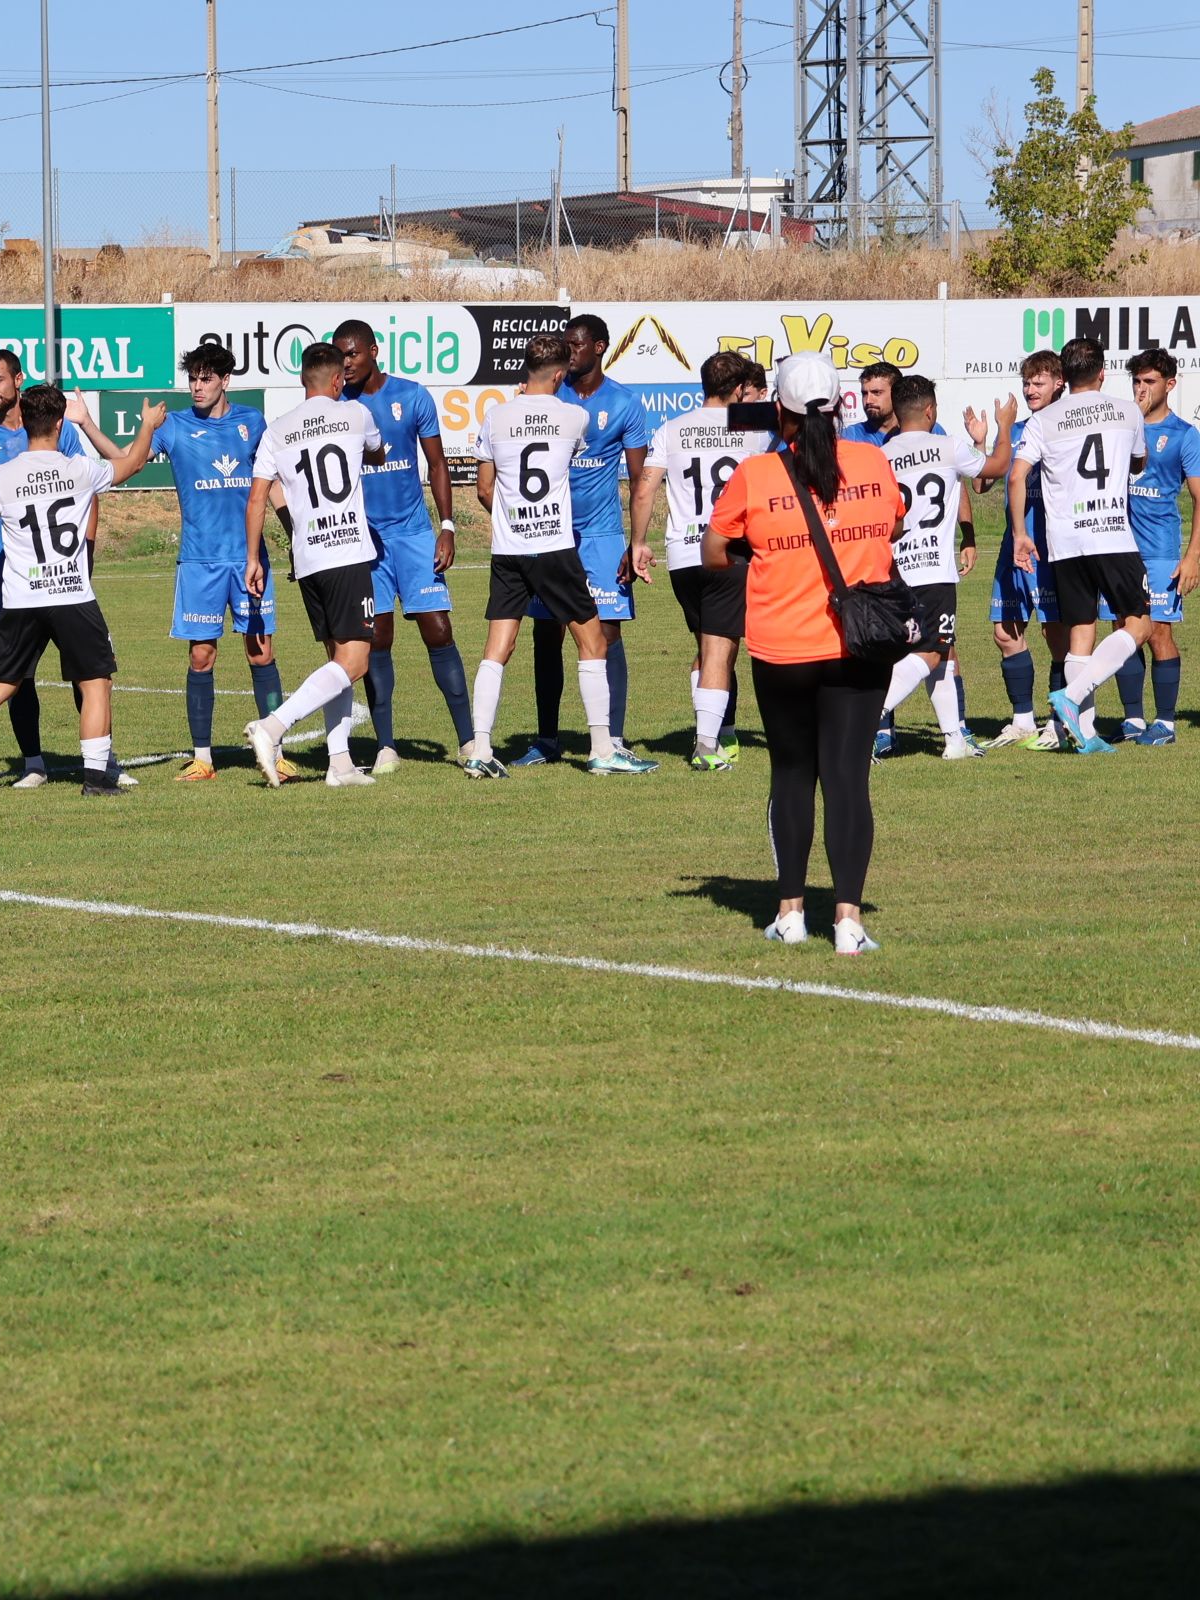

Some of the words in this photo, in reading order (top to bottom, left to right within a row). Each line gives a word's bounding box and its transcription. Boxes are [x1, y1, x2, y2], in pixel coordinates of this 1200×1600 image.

[492, 337, 508, 349] DE
[780, 312, 919, 371] Viso
[492, 358, 502, 370] T.
[504, 358, 525, 371] 627
[965, 361, 1003, 374] PABLO
[1064, 400, 1114, 420] CARNICERÍA
[303, 415, 325, 428] BAR
[524, 414, 548, 425] BAR
[1057, 418, 1093, 432] MANOLO
[1093, 415, 1099, 424] Y
[1102, 411, 1125, 423] JULIA
[284, 431, 301, 445] SAN
[302, 421, 350, 440] FRANCISCO
[509, 426, 523, 438] LA
[524, 424, 560, 437] MARNE
[681, 438, 692, 449] EL
[694, 436, 744, 448] REBOLLAR
[1076, 433, 1110, 490] 4
[27, 469, 60, 484] CASA
[294, 443, 352, 509] 10
[519, 442, 550, 503] 6
[16, 479, 75, 498] FAUSTINO
[194, 478, 222, 490] CAJA
[517, 502, 561, 520] MILAR
[1086, 496, 1125, 512] MILAR
[317, 511, 357, 531] MILAR
[1073, 517, 1099, 529] SIEGA
[1100, 515, 1125, 527] VERDE
[18, 496, 80, 565] 16
[307, 532, 331, 545] SIEGA
[331, 527, 360, 541] VERDE
[524, 531, 542, 540] CASA
[830, 522, 889, 544] RODRIGO
[1091, 525, 1110, 534] CASA
[323, 540, 341, 548] CASA
[341, 536, 361, 546] RURAL
[898, 535, 939, 555] MILAR
[911, 551, 939, 563] VERDE
[42, 559, 79, 578] MILAR
[903, 563, 920, 572] CASA
[29, 578, 56, 591] SIEGA
[58, 575, 83, 587] VERDE
[48, 587, 66, 595] CASA
[67, 585, 84, 594] RURAL
[360, 597, 375, 618] 10
[938, 613, 955, 634] 23
